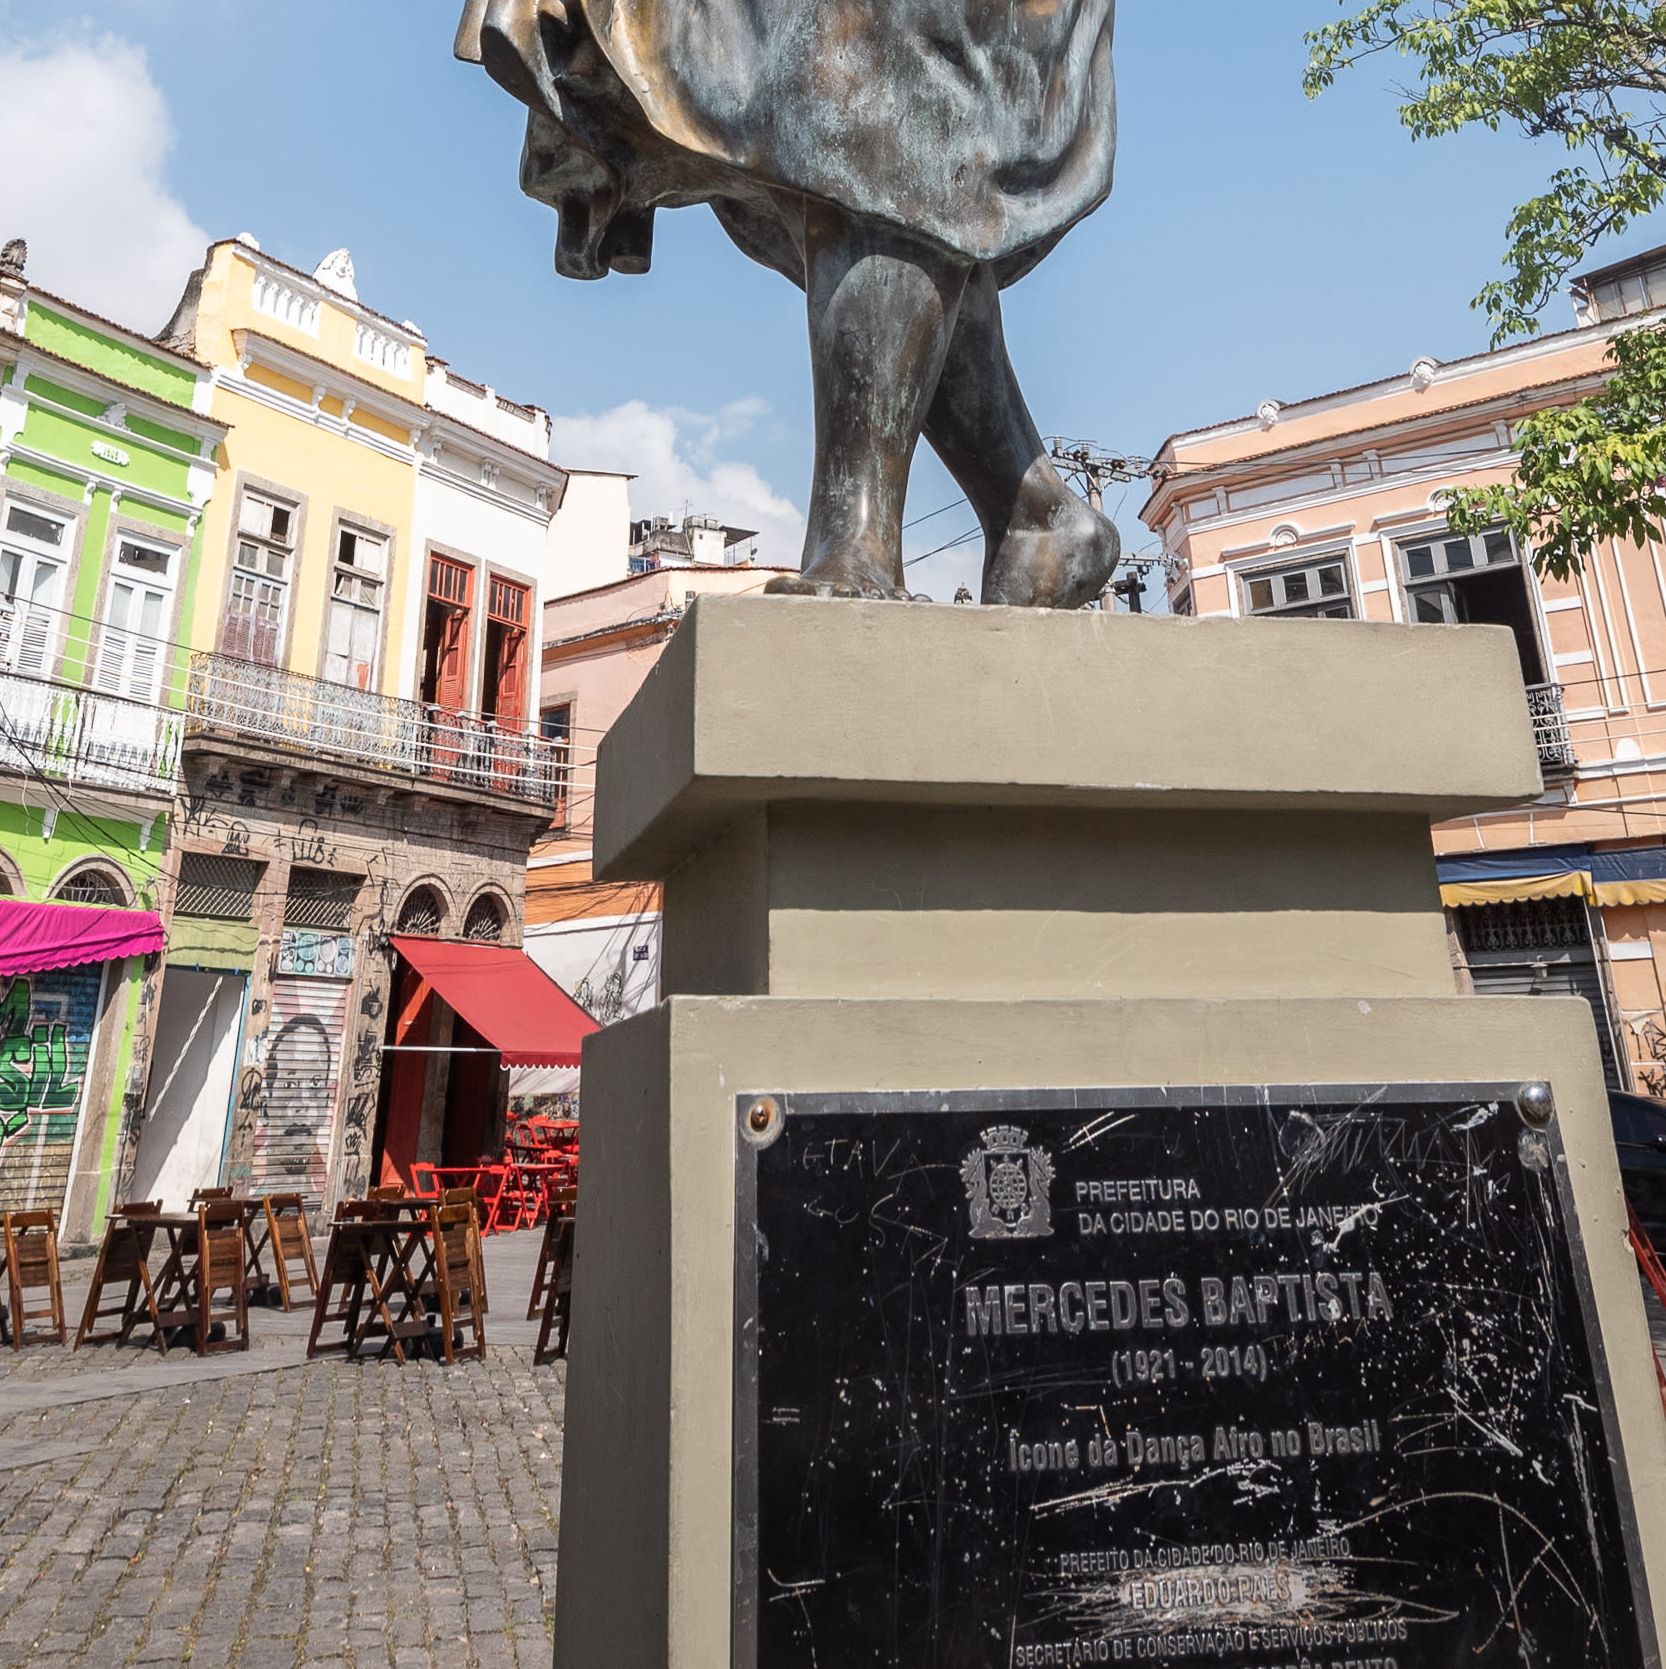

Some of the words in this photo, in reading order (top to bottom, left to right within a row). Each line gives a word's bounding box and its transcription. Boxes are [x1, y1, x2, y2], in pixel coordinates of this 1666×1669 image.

[1076, 1179, 1201, 1202] PREFEITURA
[1078, 1213, 1106, 1235] DA
[1110, 1210, 1185, 1234] CIDADE
[1191, 1209, 1220, 1231] DO
[1225, 1208, 1258, 1230] RIO
[1264, 1207, 1291, 1229] DE
[1296, 1205, 1379, 1228] JANEIRO
[965, 1277, 1190, 1336] MERCEDES
[1201, 1271, 1394, 1326] BAPTISTA
[1112, 1348, 1175, 1388] (1921
[1201, 1344, 1267, 1382] 2014)
[1008, 1429, 1079, 1471] Ícone
[1088, 1436, 1118, 1467] da
[1126, 1429, 1205, 1470] Dança
[1213, 1426, 1263, 1460] Afro
[1271, 1430, 1302, 1458] no
[1308, 1419, 1381, 1456] Brasil
[1060, 1548, 1129, 1574] PREFEITO
[1134, 1545, 1155, 1569] DA
[1158, 1543, 1211, 1569] CIDADE
[1213, 1542, 1234, 1564] DO
[1238, 1541, 1264, 1563] RIO
[1268, 1540, 1287, 1562] DE
[1291, 1536, 1350, 1560] JANEIRO
[1132, 1576, 1232, 1610] EDUARDO
[1237, 1570, 1293, 1603] PAES
[1015, 1635, 1109, 1667] SECRETÁRIO
[1113, 1635, 1133, 1658] DE
[1137, 1622, 1245, 1657] CONSERVAÇÃO
[1249, 1629, 1259, 1650] E
[1262, 1622, 1333, 1652] SERVIÇOS
[1337, 1617, 1408, 1643] PÚBLICOS
